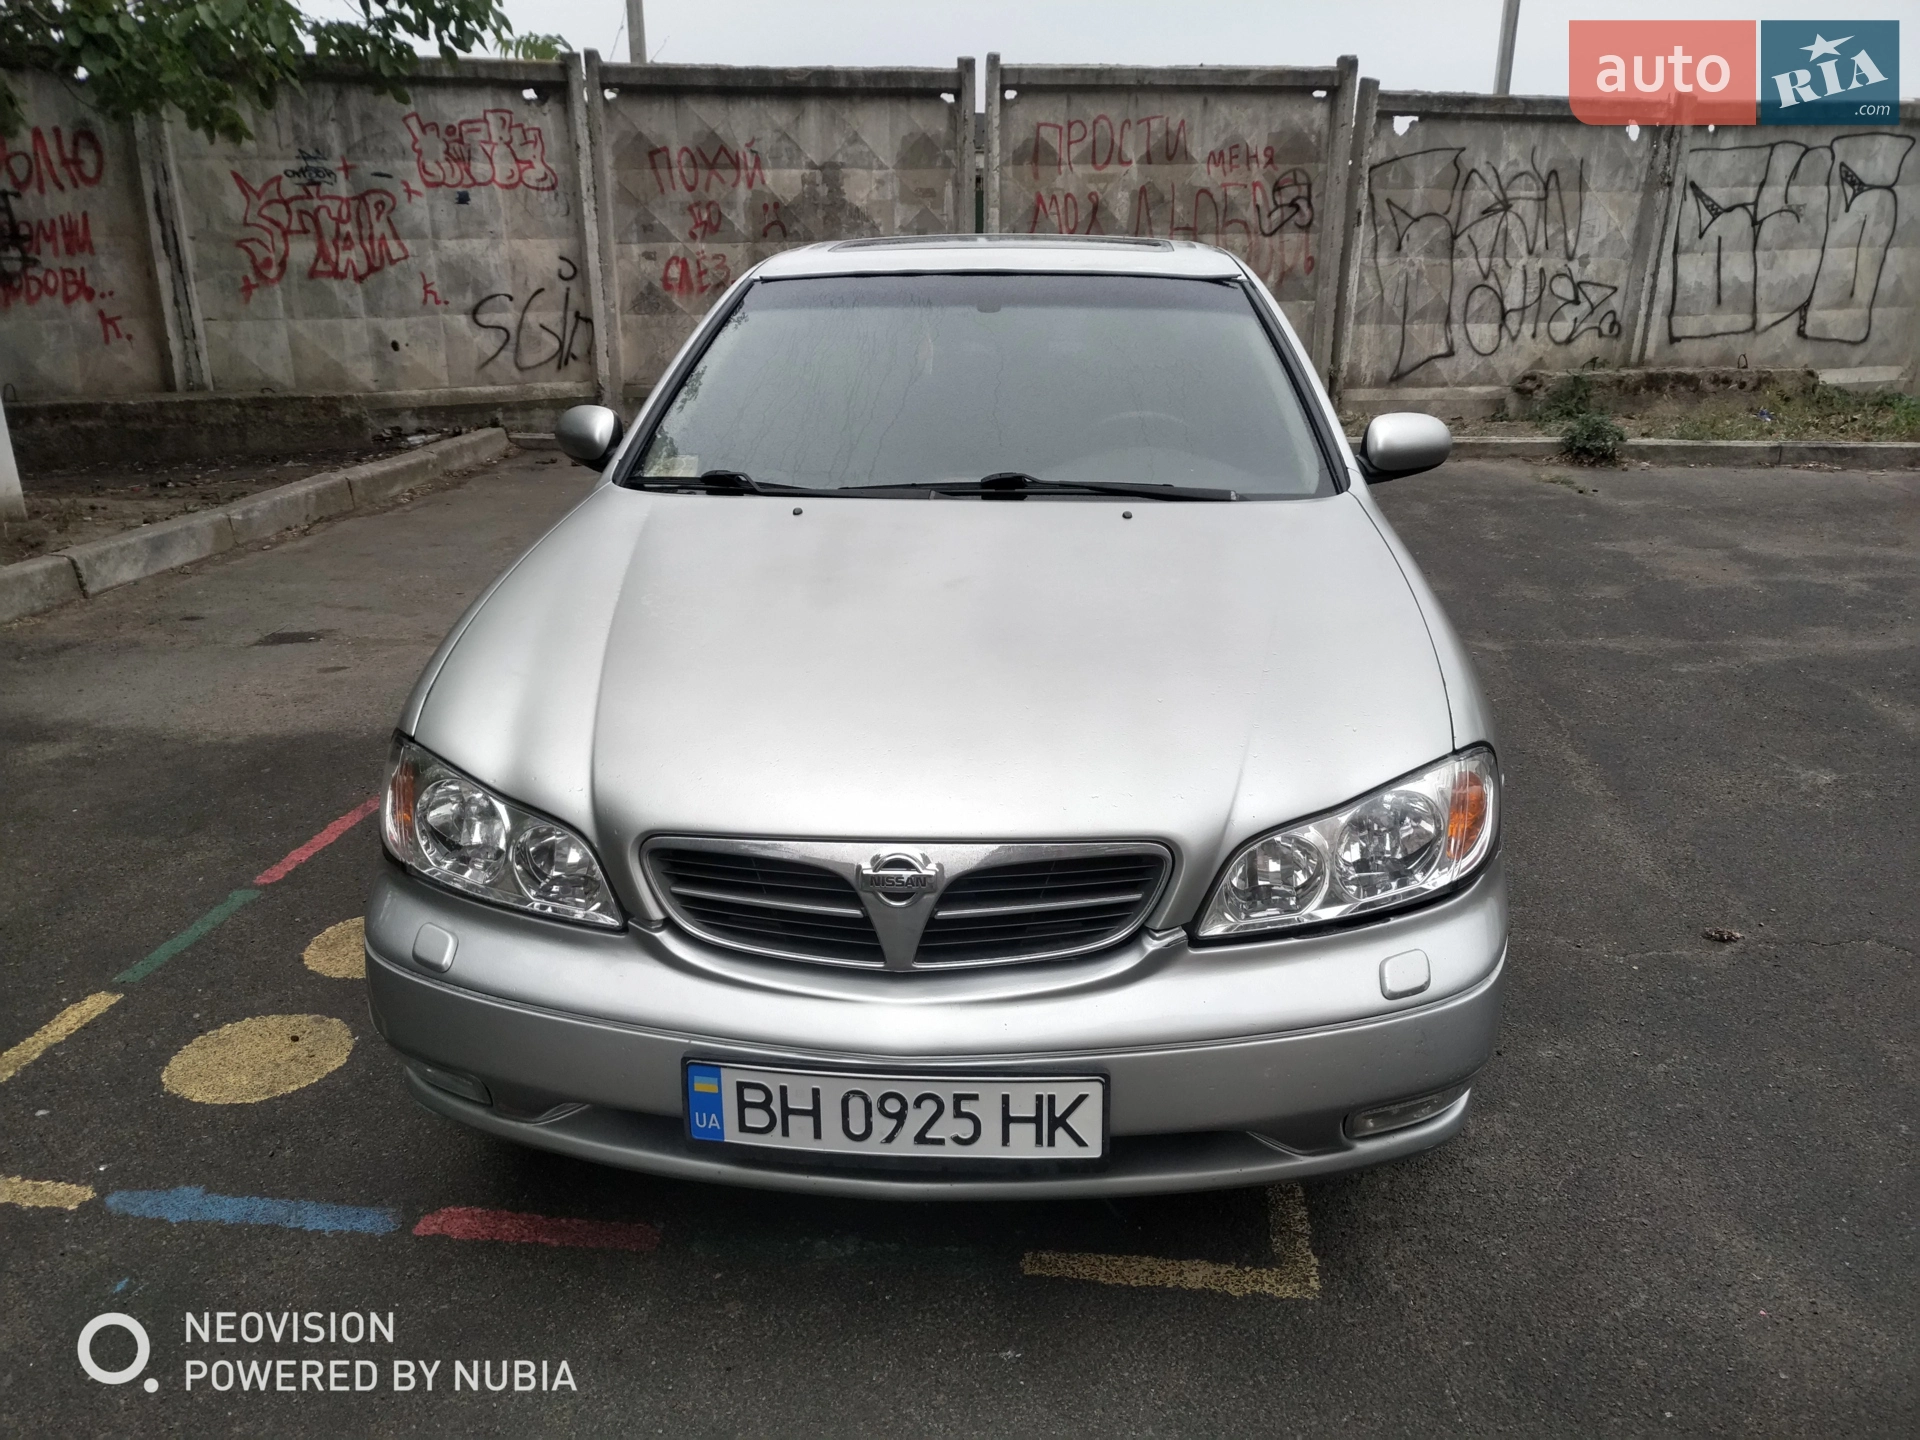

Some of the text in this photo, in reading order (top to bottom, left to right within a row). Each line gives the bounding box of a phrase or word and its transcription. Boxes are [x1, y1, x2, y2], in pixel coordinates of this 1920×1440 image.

[649, 136, 766, 195] ПОХУЙ
[1031, 113, 1189, 180] ПРОСТИ
[1206, 143, 1279, 176] МЕНЯ
[1029, 190, 1105, 235] МОЯ
[870, 874, 927, 888] NISSAN
[695, 1112, 721, 1131] UA
[735, 1079, 1090, 1148] BH 0925 HK
